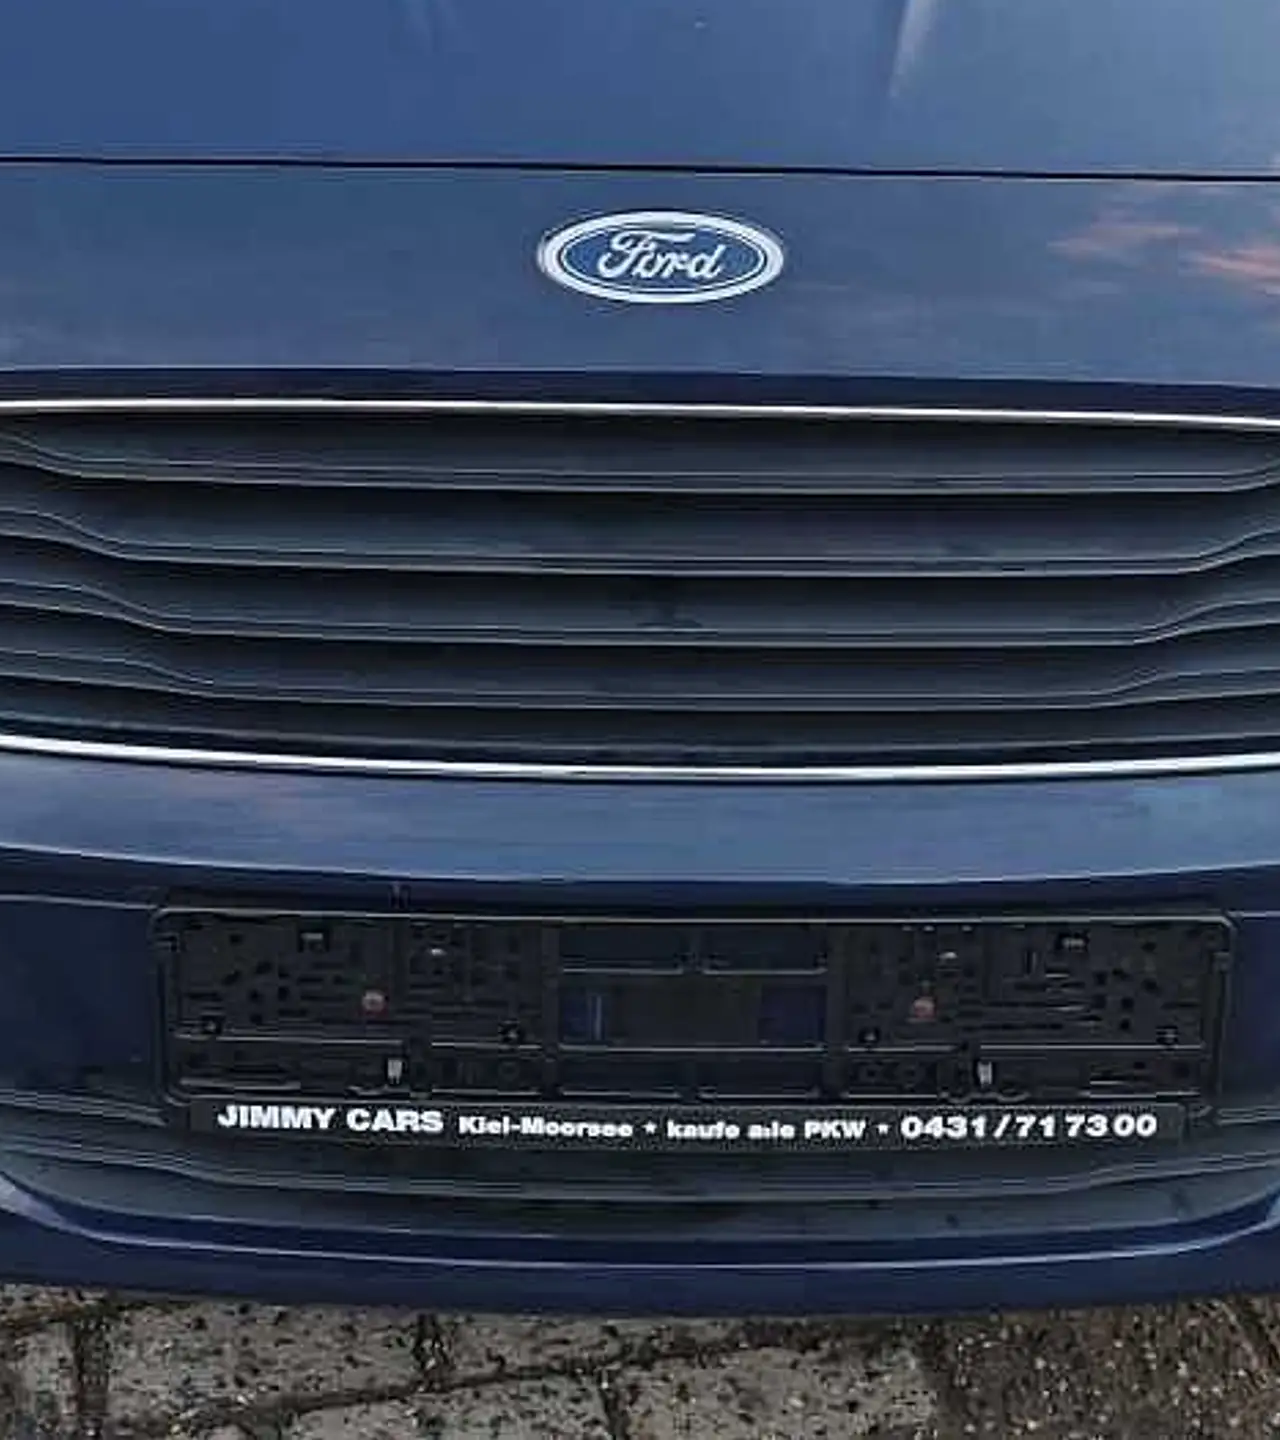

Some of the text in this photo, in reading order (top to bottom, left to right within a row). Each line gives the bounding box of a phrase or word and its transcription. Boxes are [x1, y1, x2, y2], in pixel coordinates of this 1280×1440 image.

[596, 230, 726, 279] Ford
[217, 1105, 336, 1129] JIMMY
[346, 1108, 444, 1133] CARS
[458, 1115, 634, 1138] Kiel-Moorsee
[666, 1119, 741, 1140] kaufe
[804, 1119, 867, 1140] PKW
